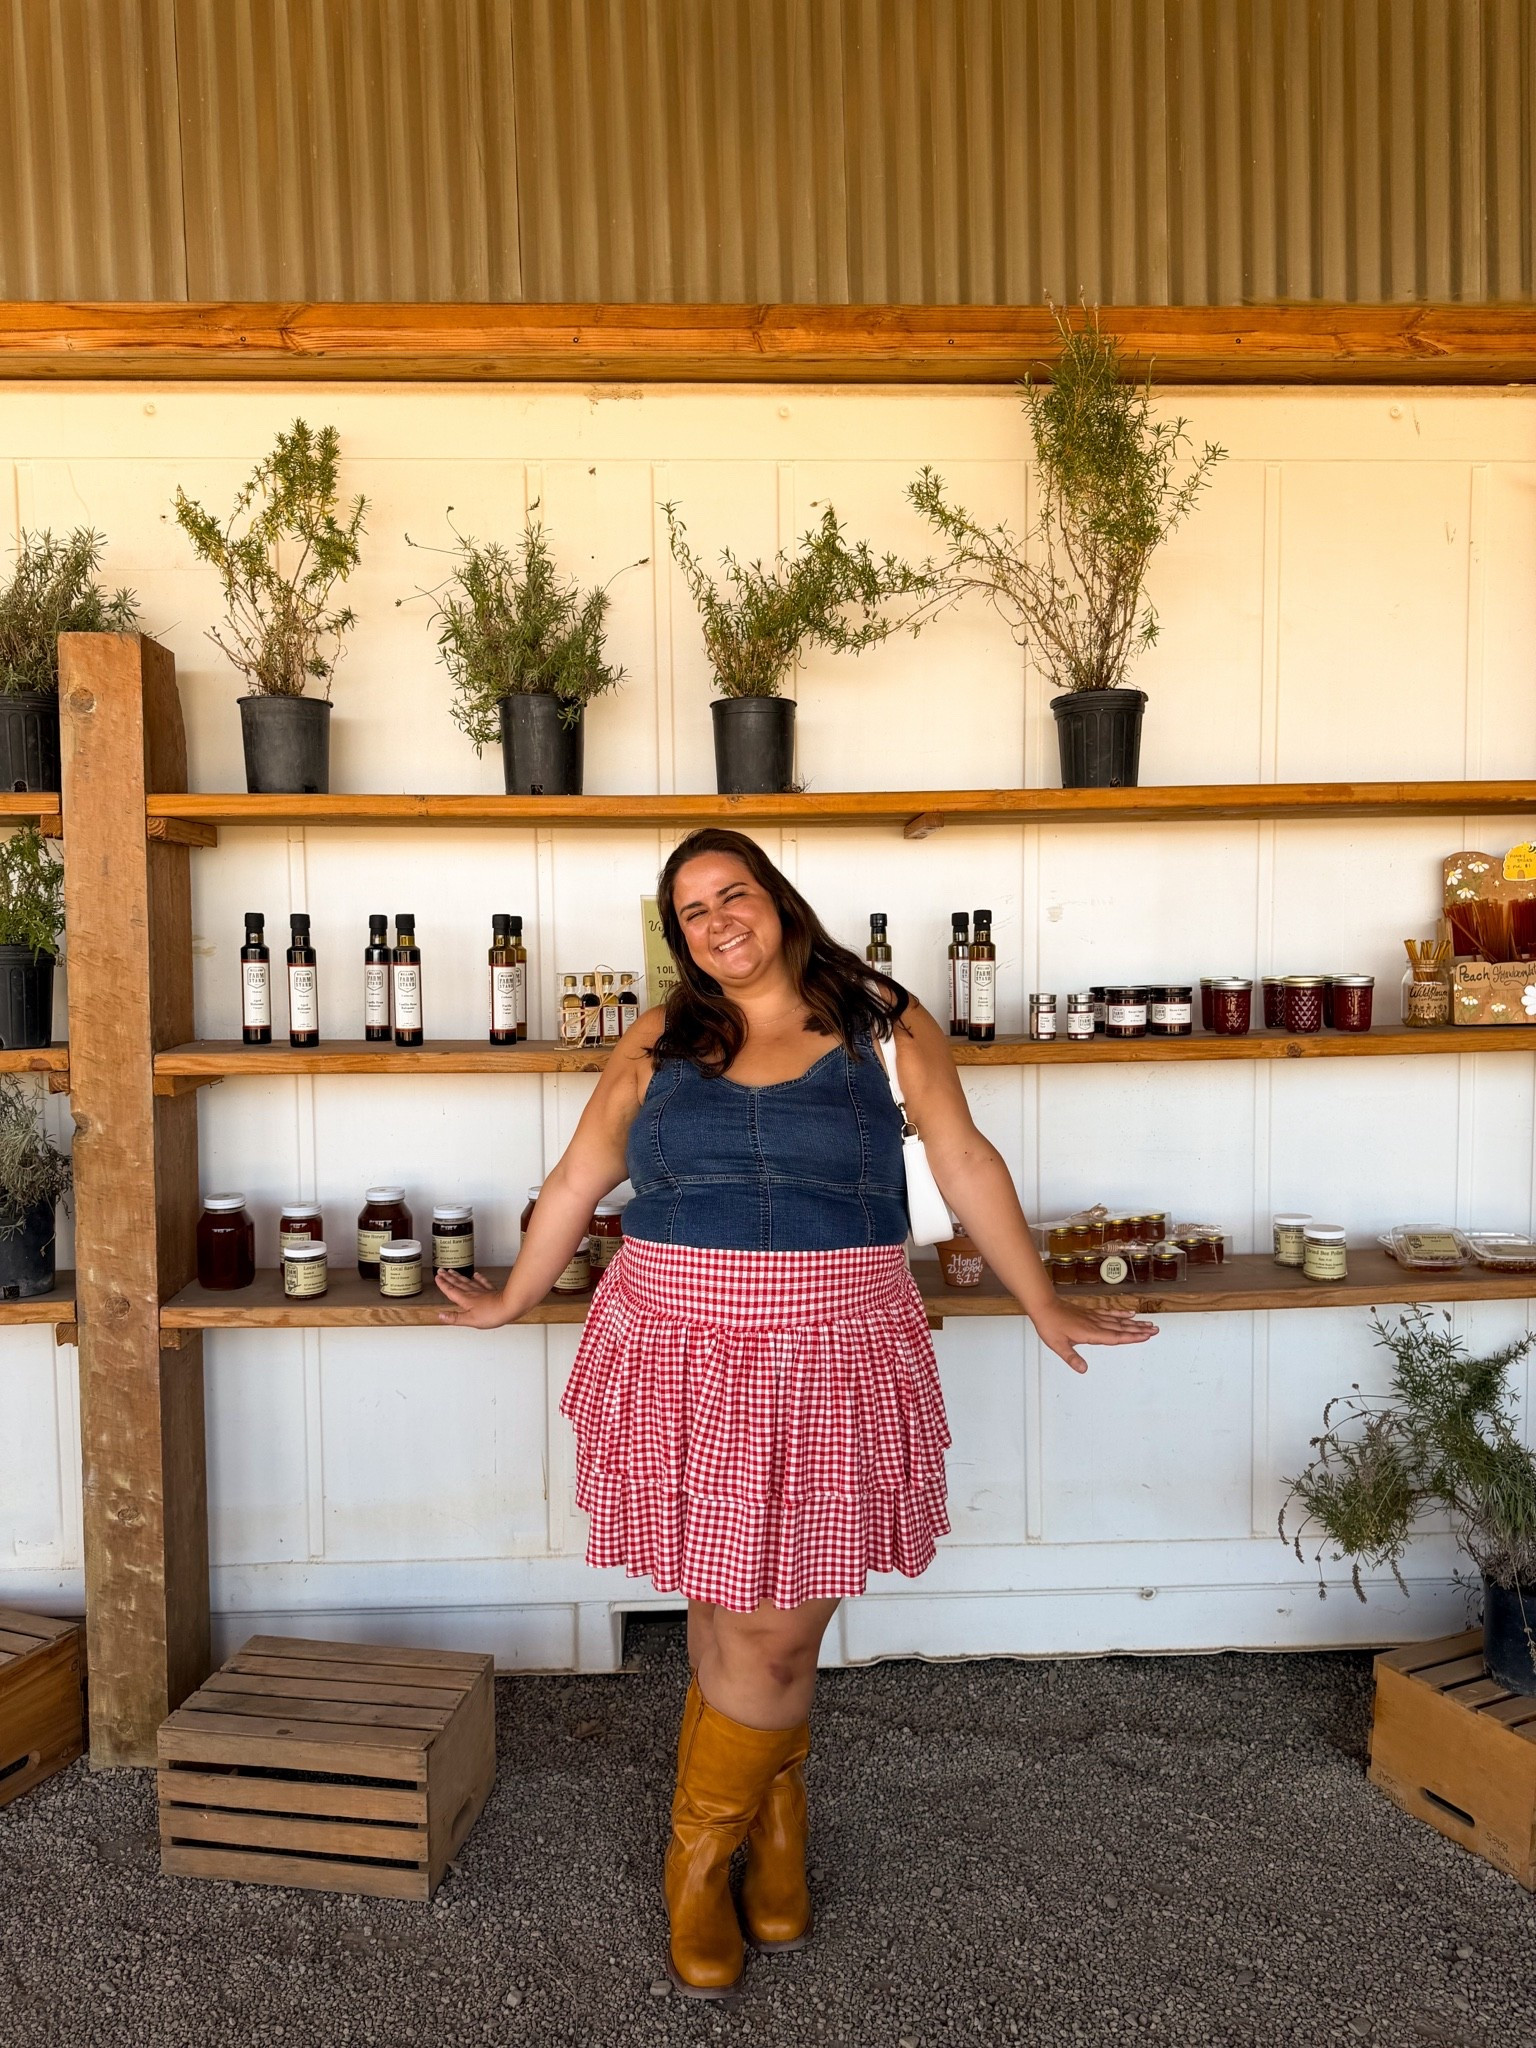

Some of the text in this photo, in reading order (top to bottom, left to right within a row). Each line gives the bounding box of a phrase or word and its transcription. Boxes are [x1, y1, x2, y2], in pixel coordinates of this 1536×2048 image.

[657, 966, 675, 974] 1 OIL
[1459, 965, 1490, 982] Peach
[951, 1254, 982, 1267] Honey
